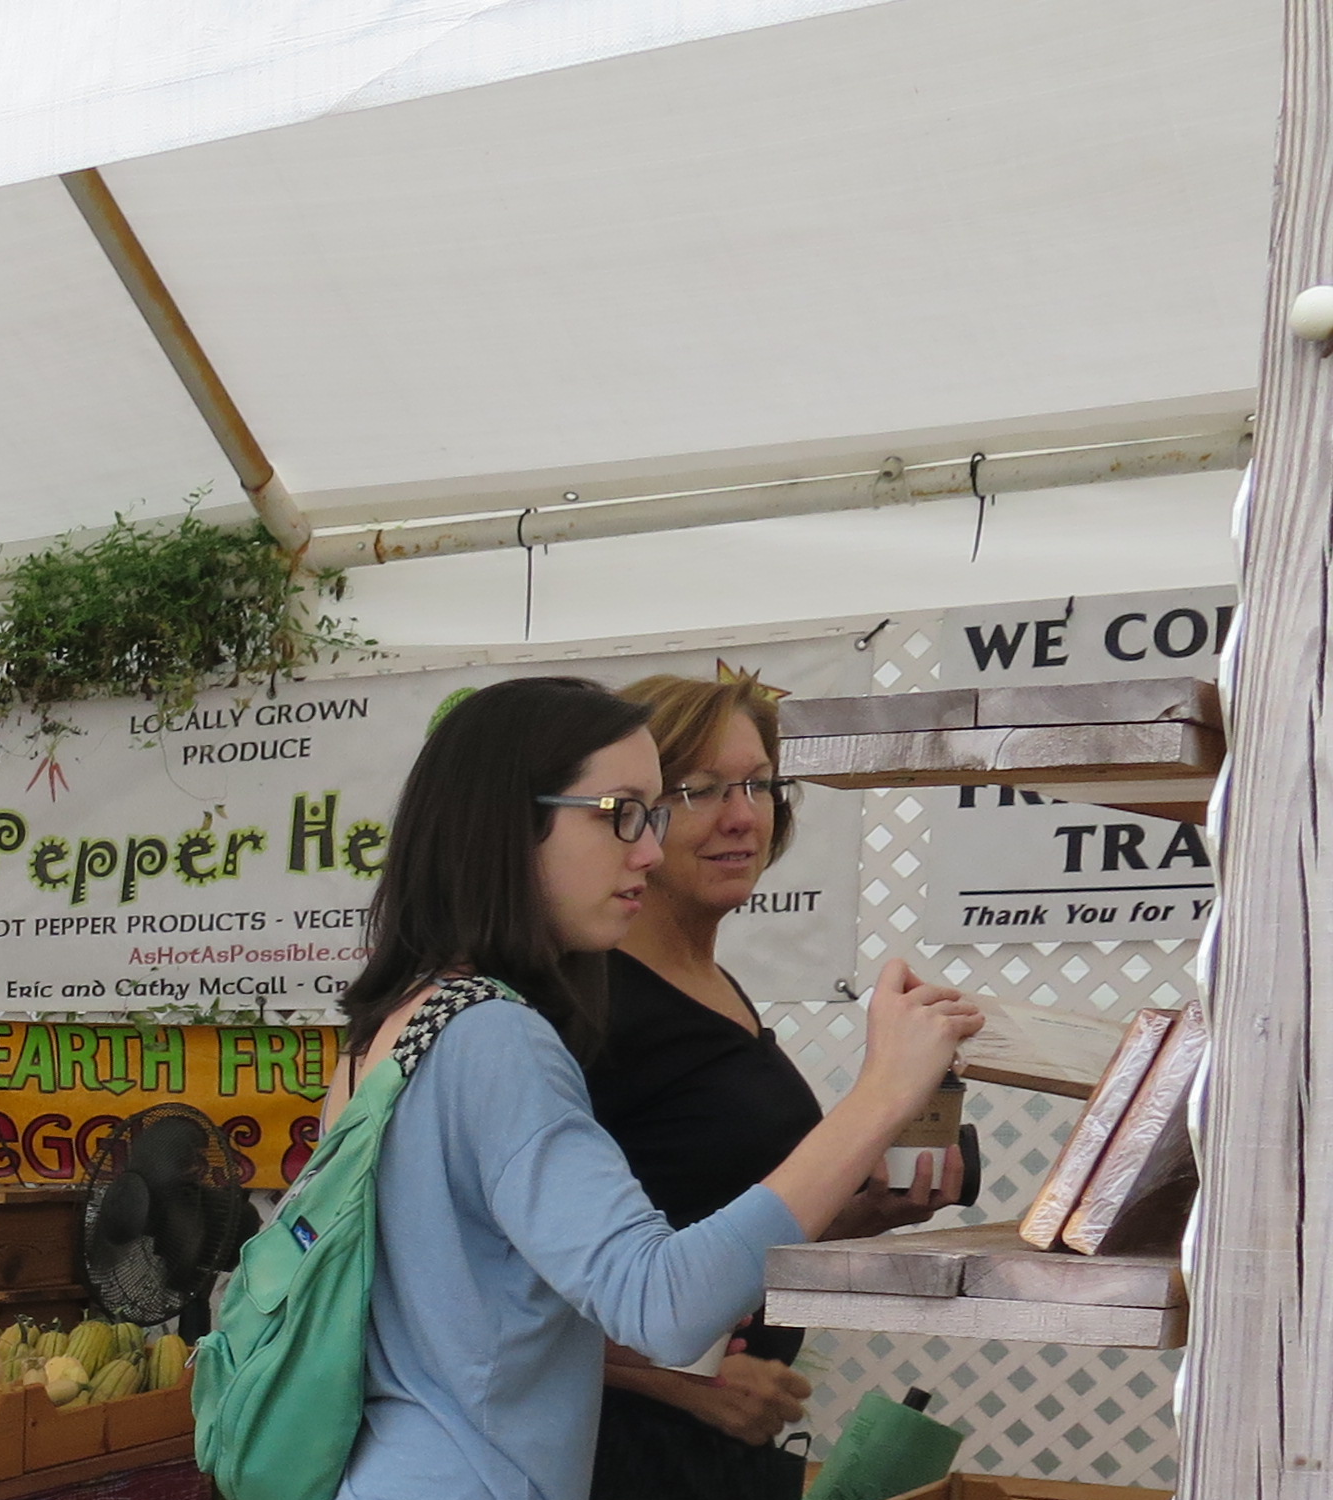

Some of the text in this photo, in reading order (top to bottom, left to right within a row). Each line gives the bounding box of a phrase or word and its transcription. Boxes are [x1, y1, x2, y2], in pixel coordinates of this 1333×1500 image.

[964, 618, 1070, 672] WE
[129, 698, 369, 736] LOCALLY GROWN
[182, 737, 312, 766] PRODUCE
[35, 915, 116, 936] PEPPER
[127, 912, 267, 934] PRODUCTS
[962, 904, 1049, 926] Thank
[1066, 903, 1118, 925] You
[1129, 901, 1175, 923] for
[6, 980, 53, 999] Eric
[61, 979, 106, 998] and
[115, 978, 190, 1001] Cathy
[199, 976, 288, 997] McCall
[218, 1024, 346, 1102] FRI
